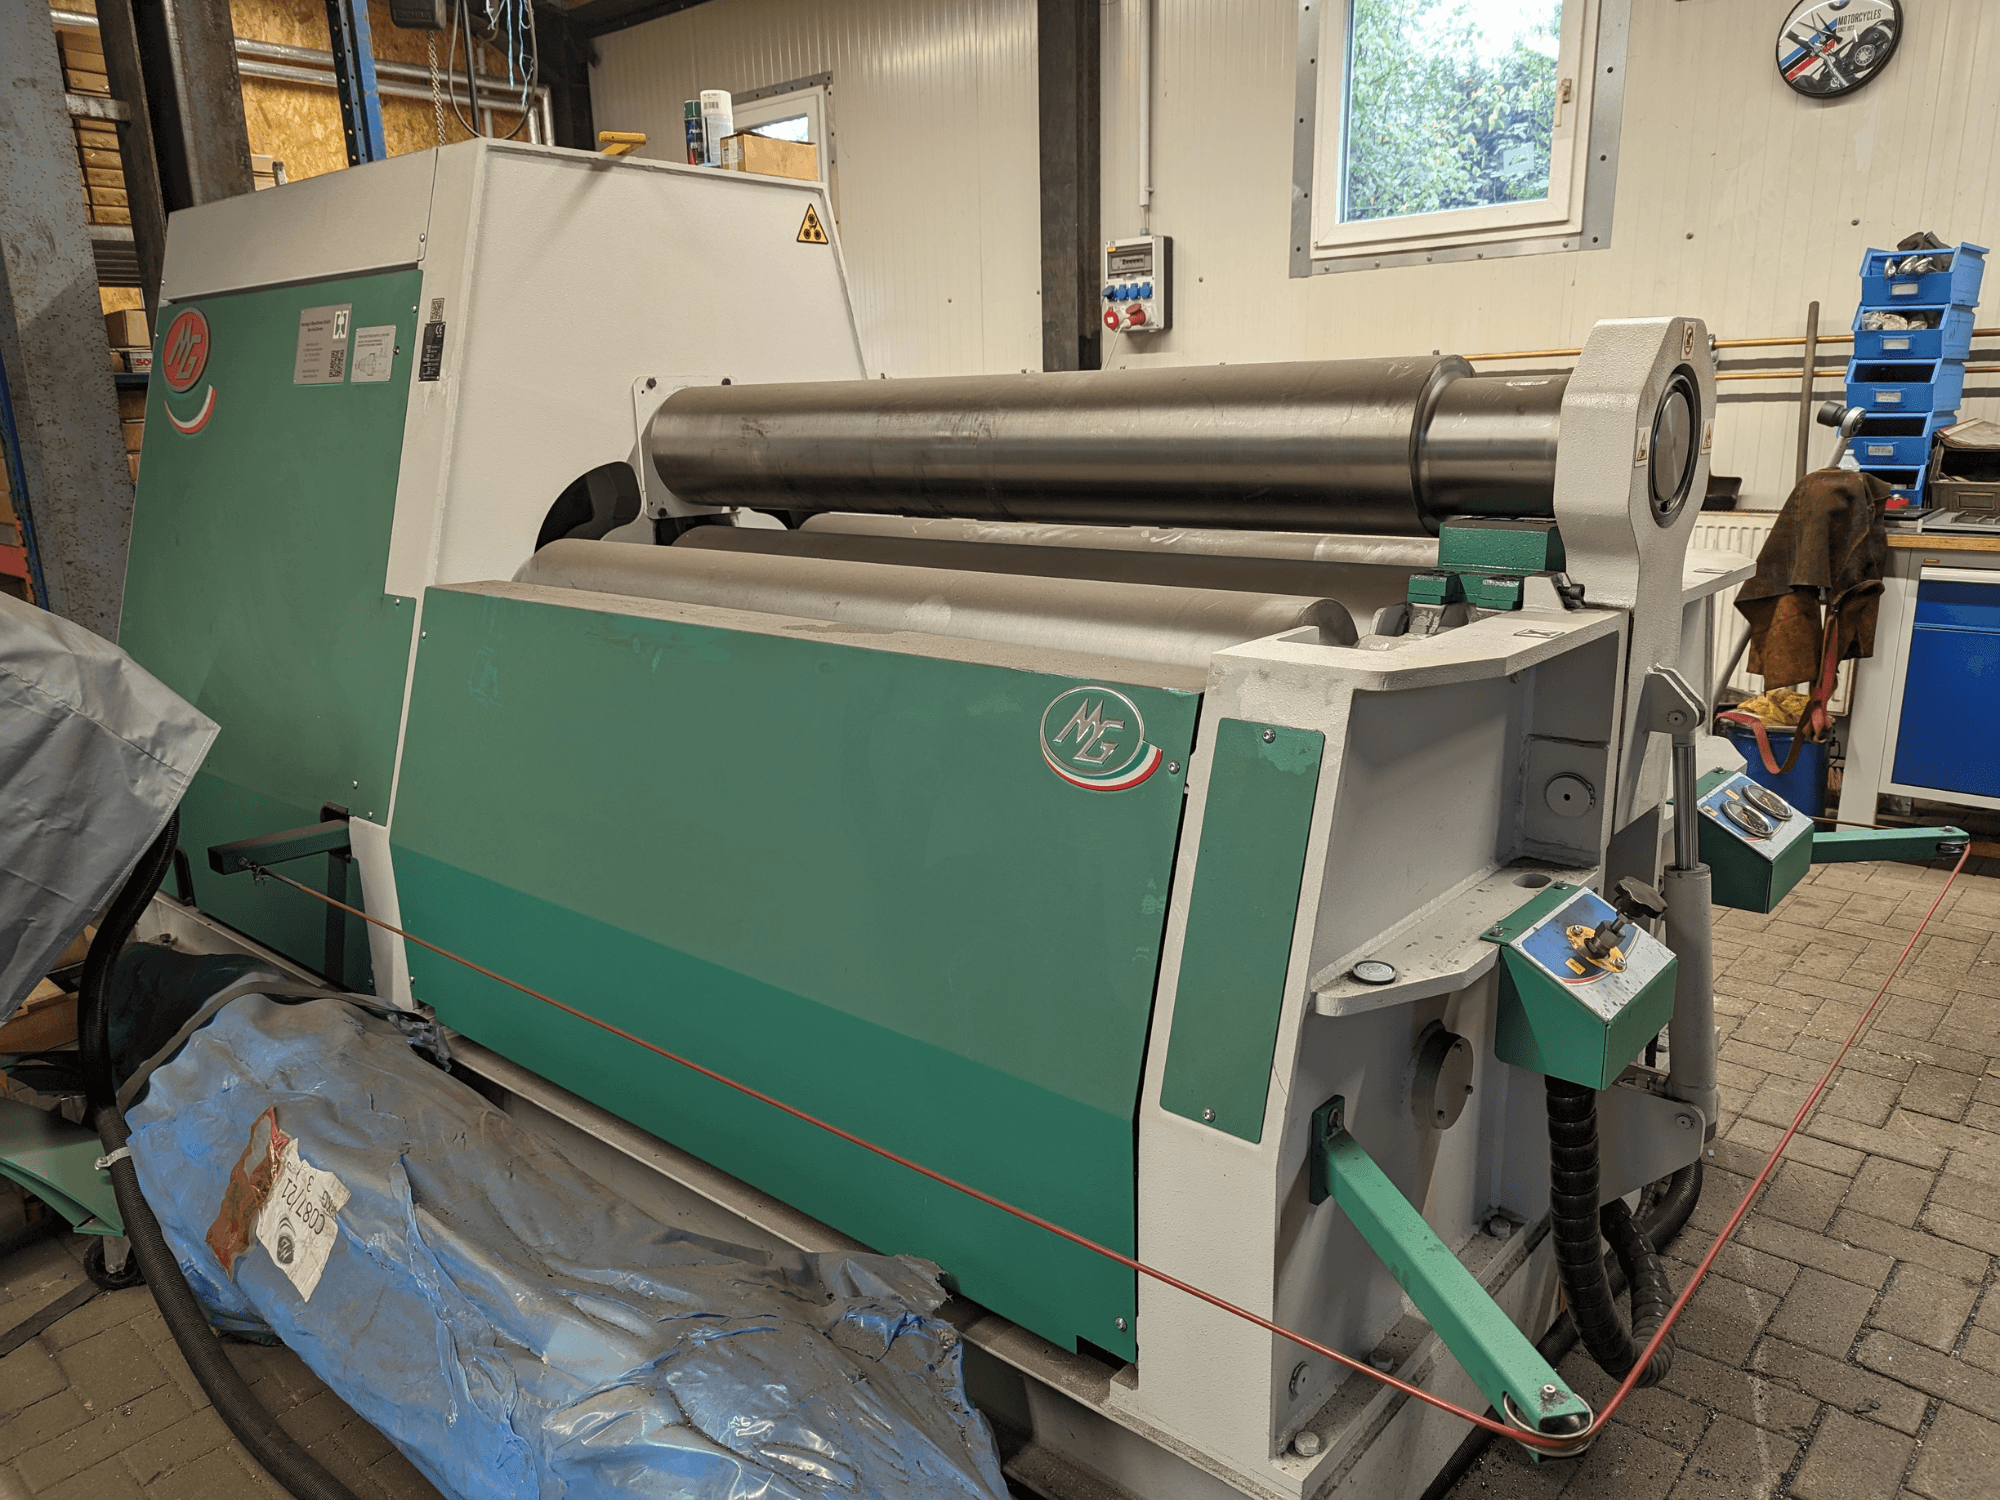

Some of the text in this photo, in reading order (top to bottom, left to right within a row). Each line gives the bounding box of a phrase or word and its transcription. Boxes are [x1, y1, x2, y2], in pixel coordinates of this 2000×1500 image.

[1837, 8, 1882, 27] MOTORCYCLES
[167, 318, 202, 380] MG
[1052, 697, 1126, 765] MG
